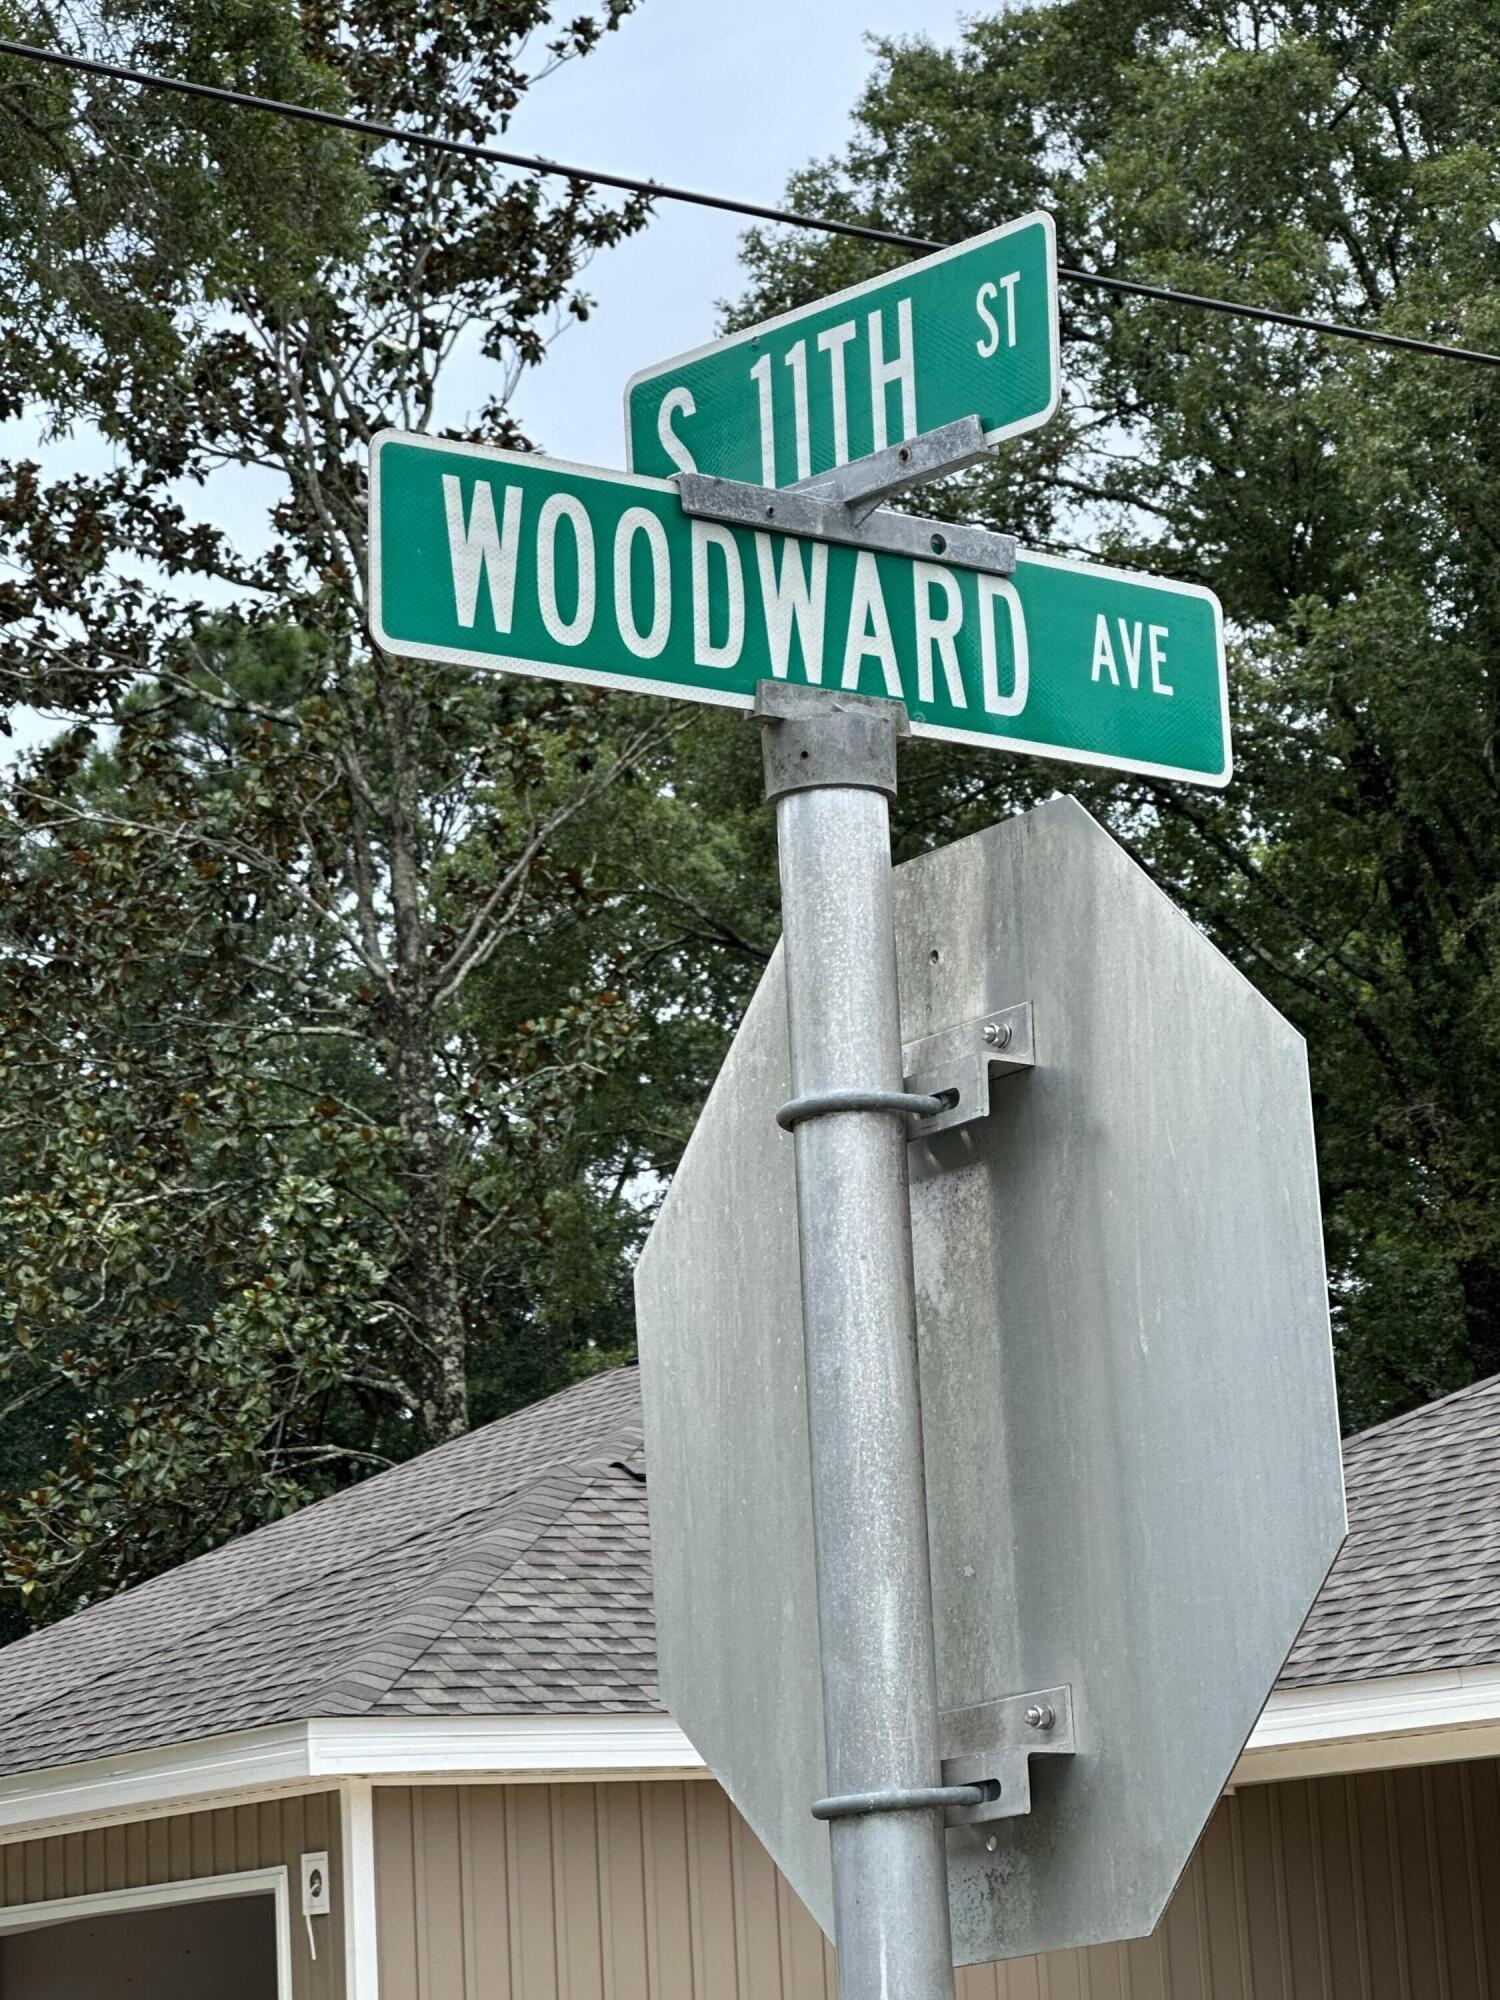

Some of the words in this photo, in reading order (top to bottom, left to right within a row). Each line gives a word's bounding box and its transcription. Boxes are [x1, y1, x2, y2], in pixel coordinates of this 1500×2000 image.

[657, 386, 698, 478] S
[749, 297, 917, 488] 11TH
[975, 271, 1021, 358] ST
[442, 474, 1029, 717] WOODWARD
[1091, 614, 1174, 696] AVE
